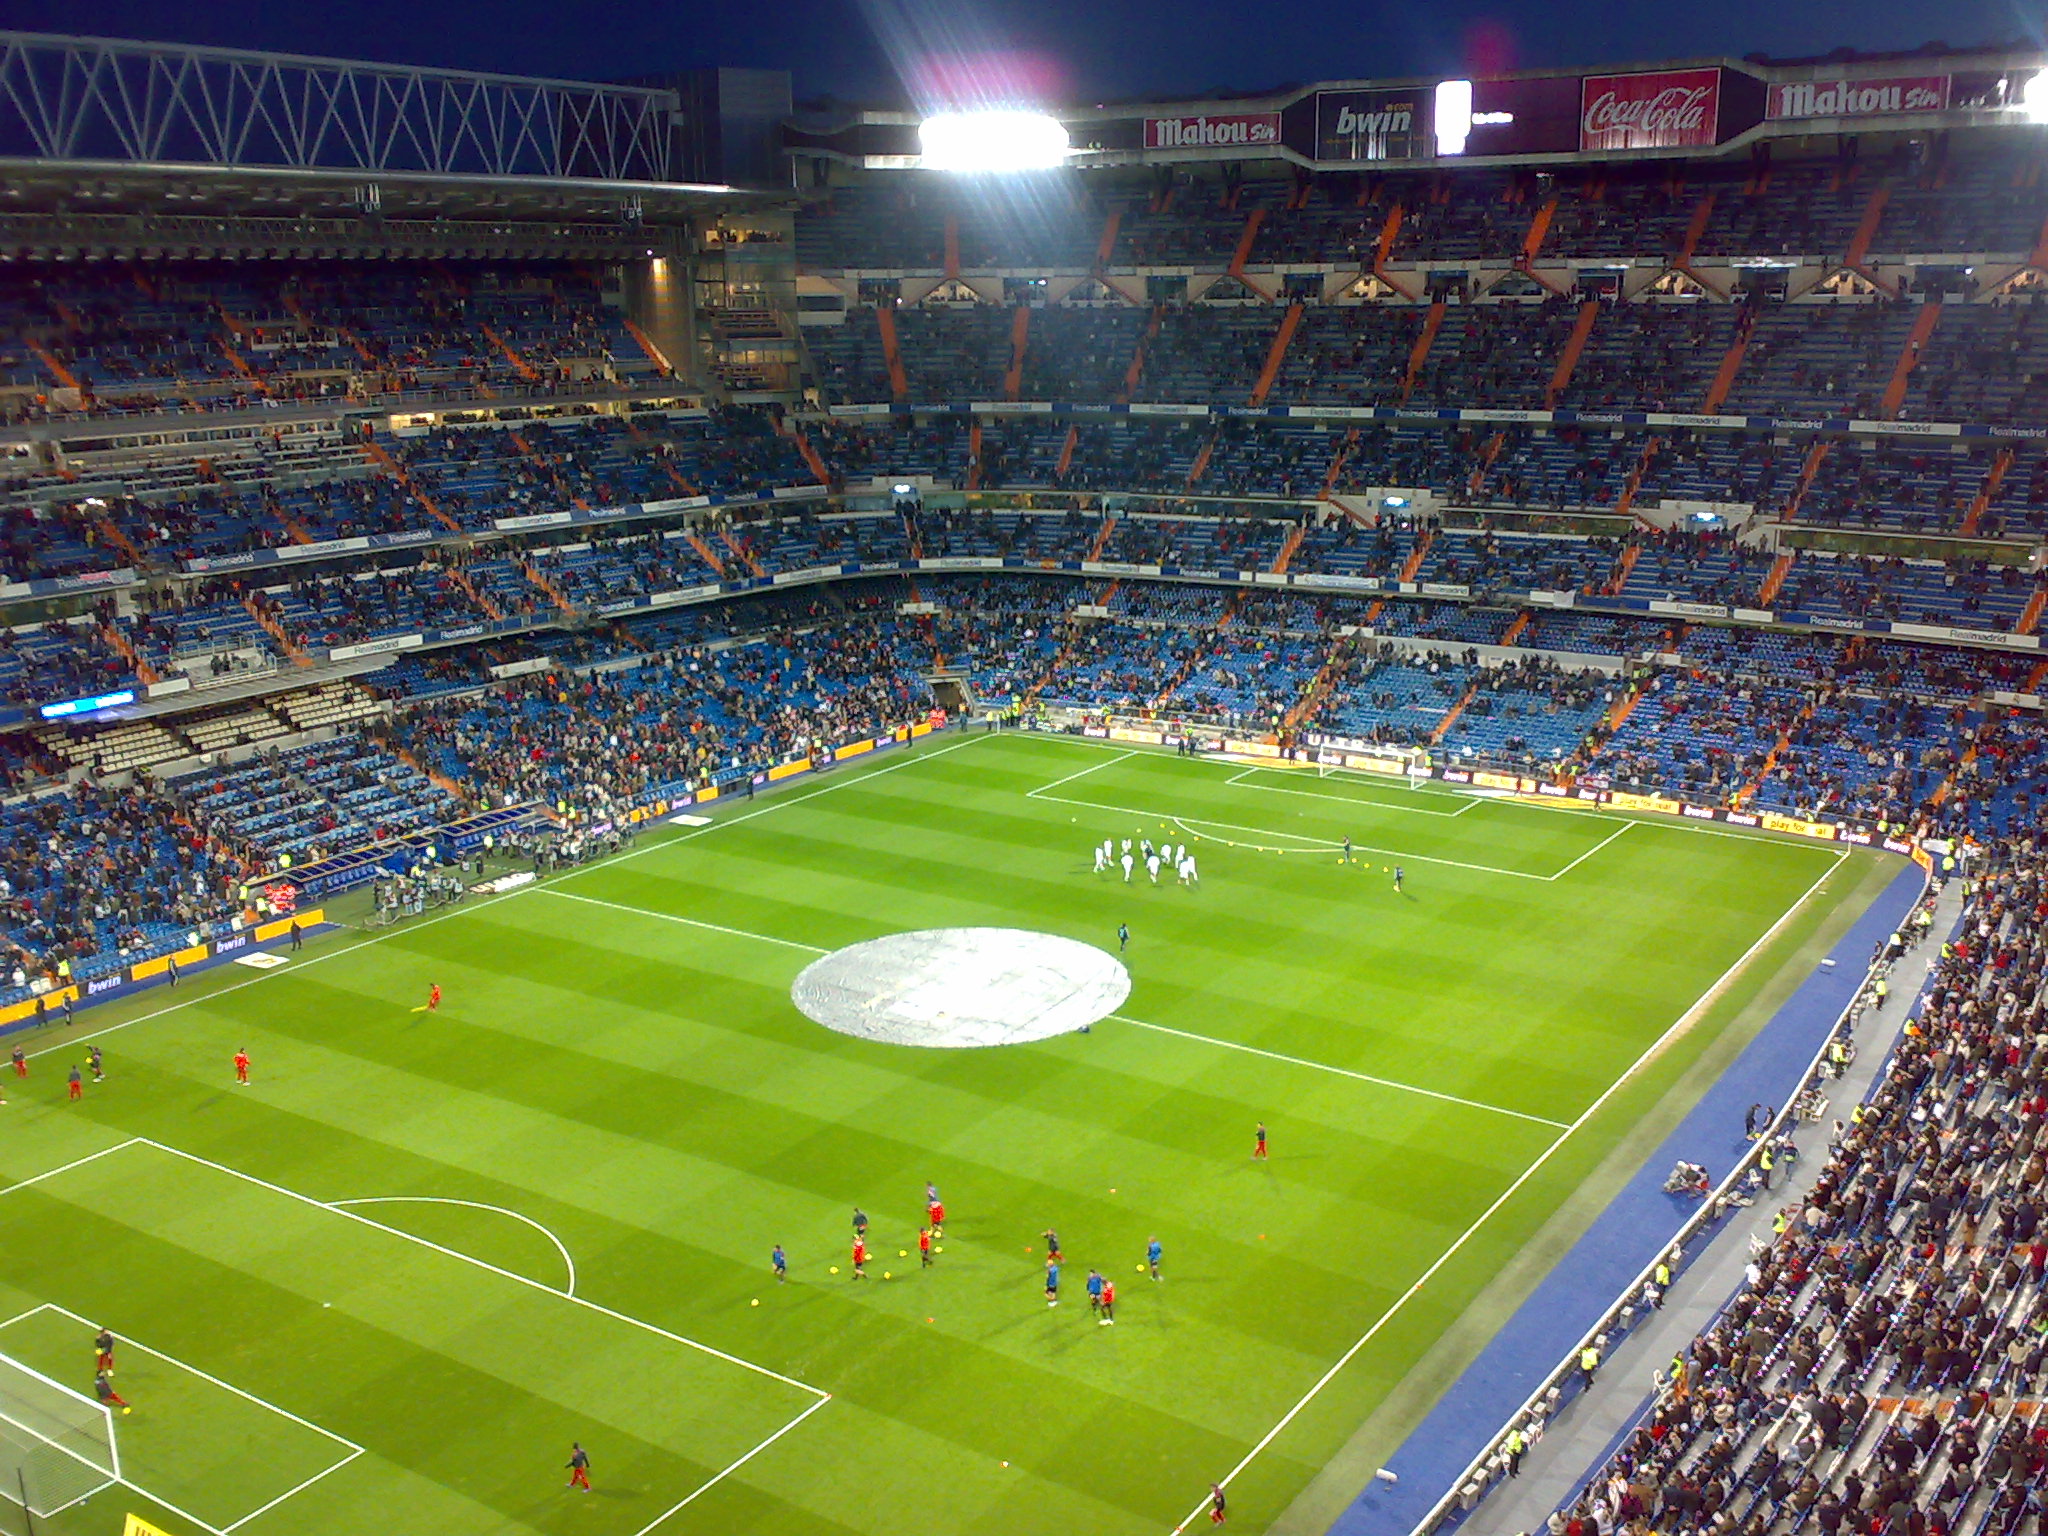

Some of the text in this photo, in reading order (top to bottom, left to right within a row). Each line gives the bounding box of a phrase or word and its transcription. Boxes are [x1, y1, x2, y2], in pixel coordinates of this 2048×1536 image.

[1781, 80, 1940, 116] Mahou Sin
[1156, 117, 1276, 146] Mahou Sin
[1336, 106, 1412, 135] bwin
[216, 936, 247, 954] bwin
[87, 974, 121, 995] bwin
